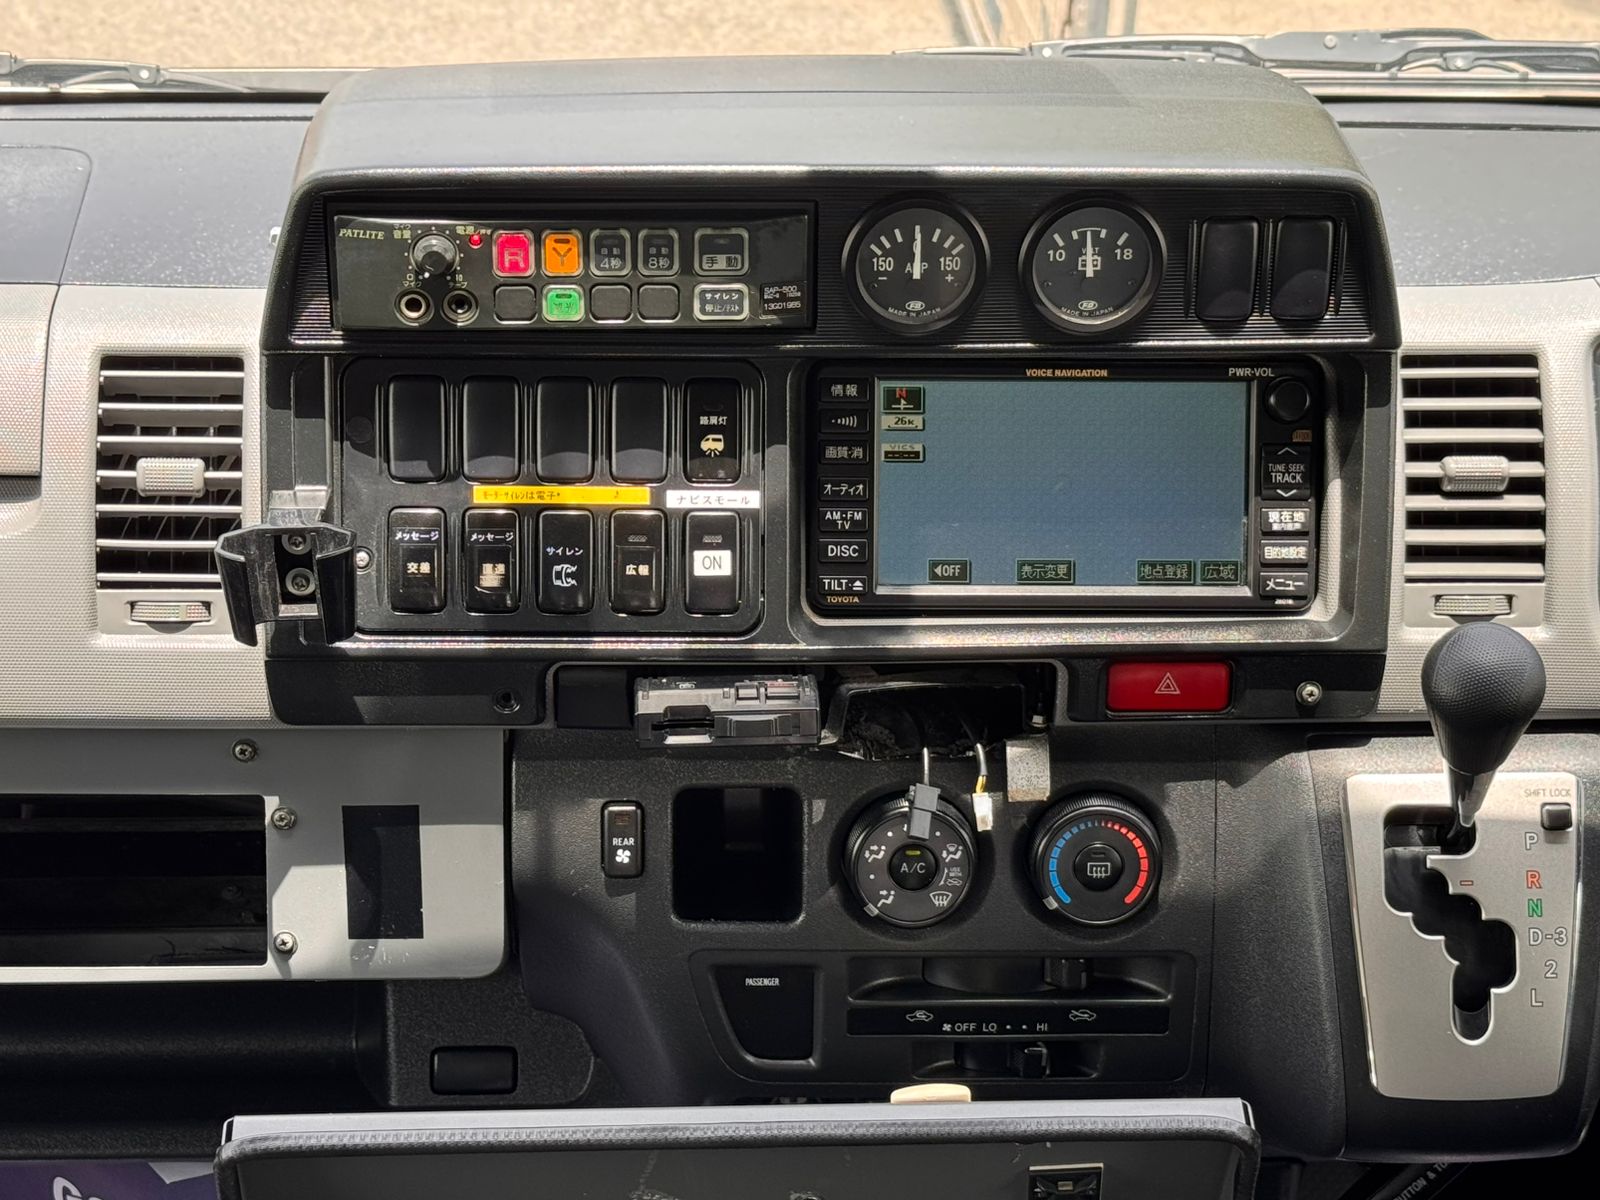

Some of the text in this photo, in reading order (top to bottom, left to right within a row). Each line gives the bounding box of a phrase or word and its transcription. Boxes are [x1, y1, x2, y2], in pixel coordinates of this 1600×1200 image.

[339, 228, 385, 240] PATLITE
[393, 230, 412, 240] 音量
[504, 248, 524, 268] R
[552, 247, 572, 266] Y
[1048, 250, 1066, 262] 10
[1114, 248, 1133, 260] 18
[600, 258, 622, 270] 4秒
[648, 257, 670, 270] 8秒
[872, 257, 894, 272] 150
[904, 262, 928, 274] AP
[939, 257, 961, 272] 150
[888, 306, 908, 316] MADE
[919, 308, 941, 316] JAPAN
[1061, 306, 1080, 317] MADE
[1091, 307, 1114, 316] JAPAN
[1025, 369, 1108, 378] VOICE NAVIGATION
[831, 384, 859, 398] 情報
[896, 388, 908, 399] N
[1270, 472, 1303, 484] TRACK
[824, 484, 864, 496] オーディオ
[676, 494, 750, 506] ナビスモール
[1268, 511, 1305, 522] 現在地
[836, 520, 851, 530] TV
[394, 530, 440, 541] メッセージ
[470, 532, 514, 542] メッセージ
[546, 546, 584, 556] サイレン
[827, 545, 860, 558] DISC
[1264, 546, 1308, 559] 目的地設定
[702, 555, 722, 570] ON
[943, 565, 961, 577] OFF
[1021, 564, 1071, 580] 表示変更
[1139, 564, 1189, 580] 地点登録
[1205, 564, 1236, 580] 広域
[1266, 578, 1305, 590] メニュー
[826, 596, 860, 604] TOYOTA
[1524, 788, 1571, 798] SHIFT LOCK
[612, 838, 635, 846] REAR
[1524, 832, 1539, 850] P
[899, 861, 926, 874] A/C
[1526, 870, 1542, 888] R
[1528, 899, 1544, 918] N
[1544, 960, 1558, 979] 2
[744, 976, 780, 987] PASSENGER
[1530, 989, 1544, 1008] L
[954, 1023, 976, 1032] OFF
[1036, 1023, 1048, 1032] HI
